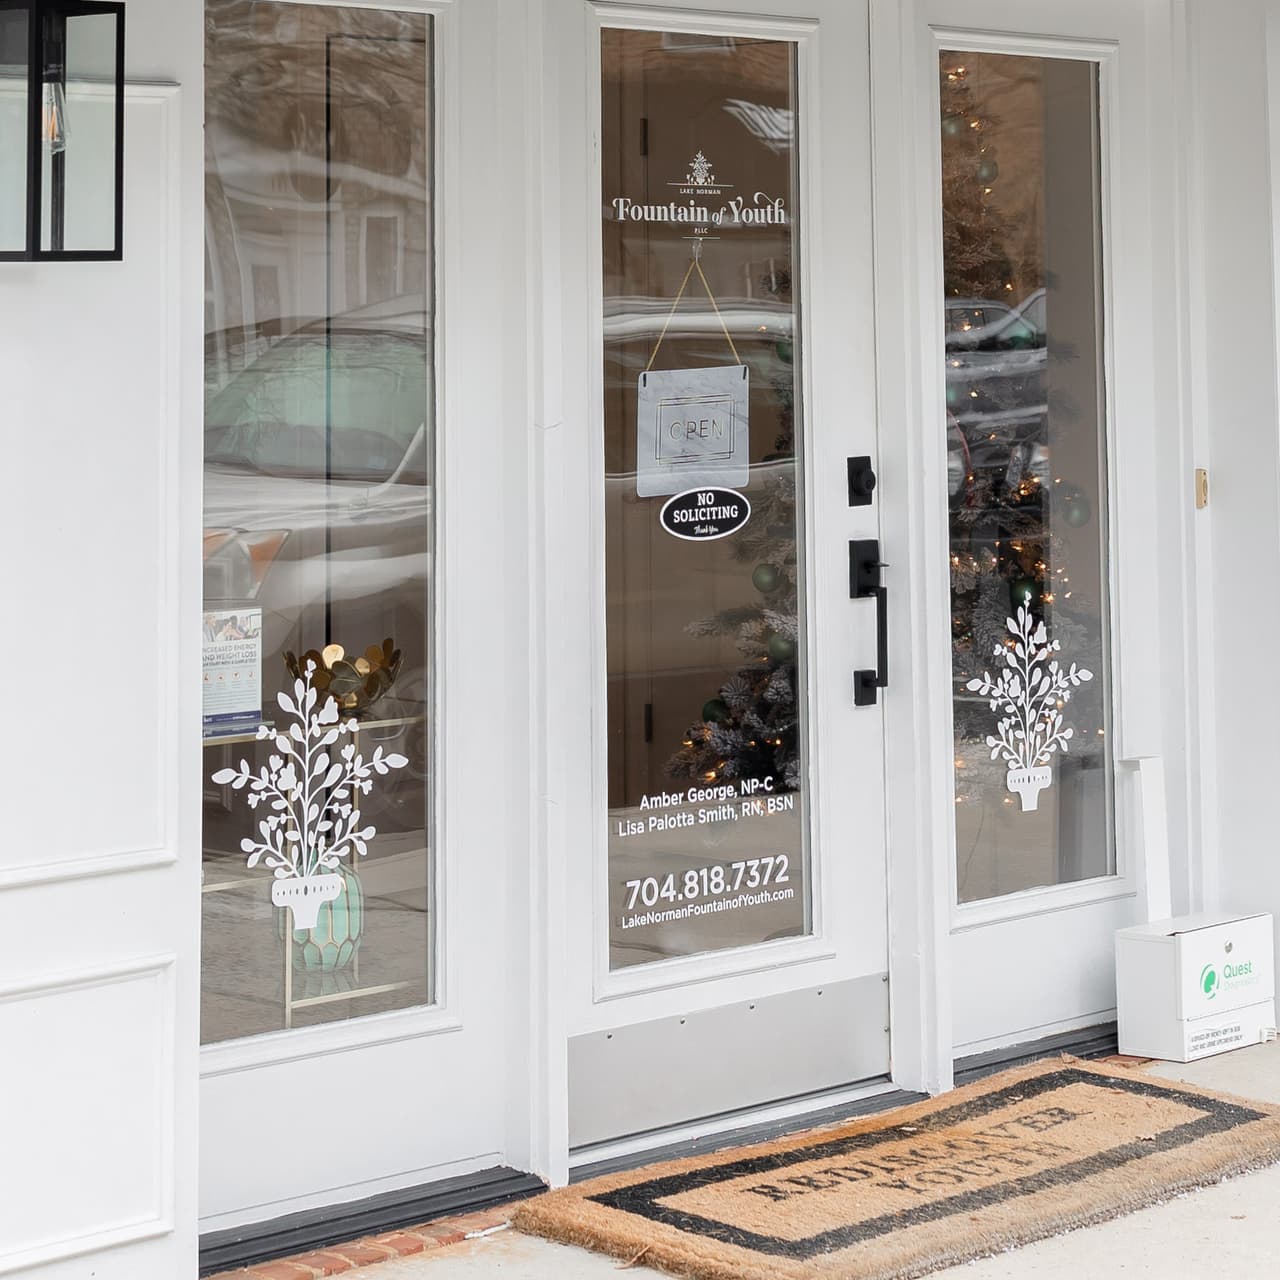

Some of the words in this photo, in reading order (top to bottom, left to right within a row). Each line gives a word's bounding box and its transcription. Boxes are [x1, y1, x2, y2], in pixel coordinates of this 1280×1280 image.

[612, 197, 708, 222] Fountain
[711, 206, 727, 225] of
[728, 191, 786, 224] Youth
[670, 418, 724, 440] OPEN
[697, 492, 715, 506] NO
[673, 505, 739, 524] SOLICITING
[241, 650, 257, 658] LOSS
[639, 792, 684, 811] Amber
[687, 785, 738, 803] George,
[741, 776, 774, 796] NP-C
[618, 821, 645, 837] Lisa
[648, 813, 695, 832] Palotta
[698, 803, 738, 824] Smith,
[742, 801, 764, 818] RN,
[767, 795, 794, 814] BSN
[626, 854, 790, 910] 704.818.7372
[622, 888, 794, 929] LakeNormanFountainofYouth.com
[1223, 959, 1252, 979] Quest
